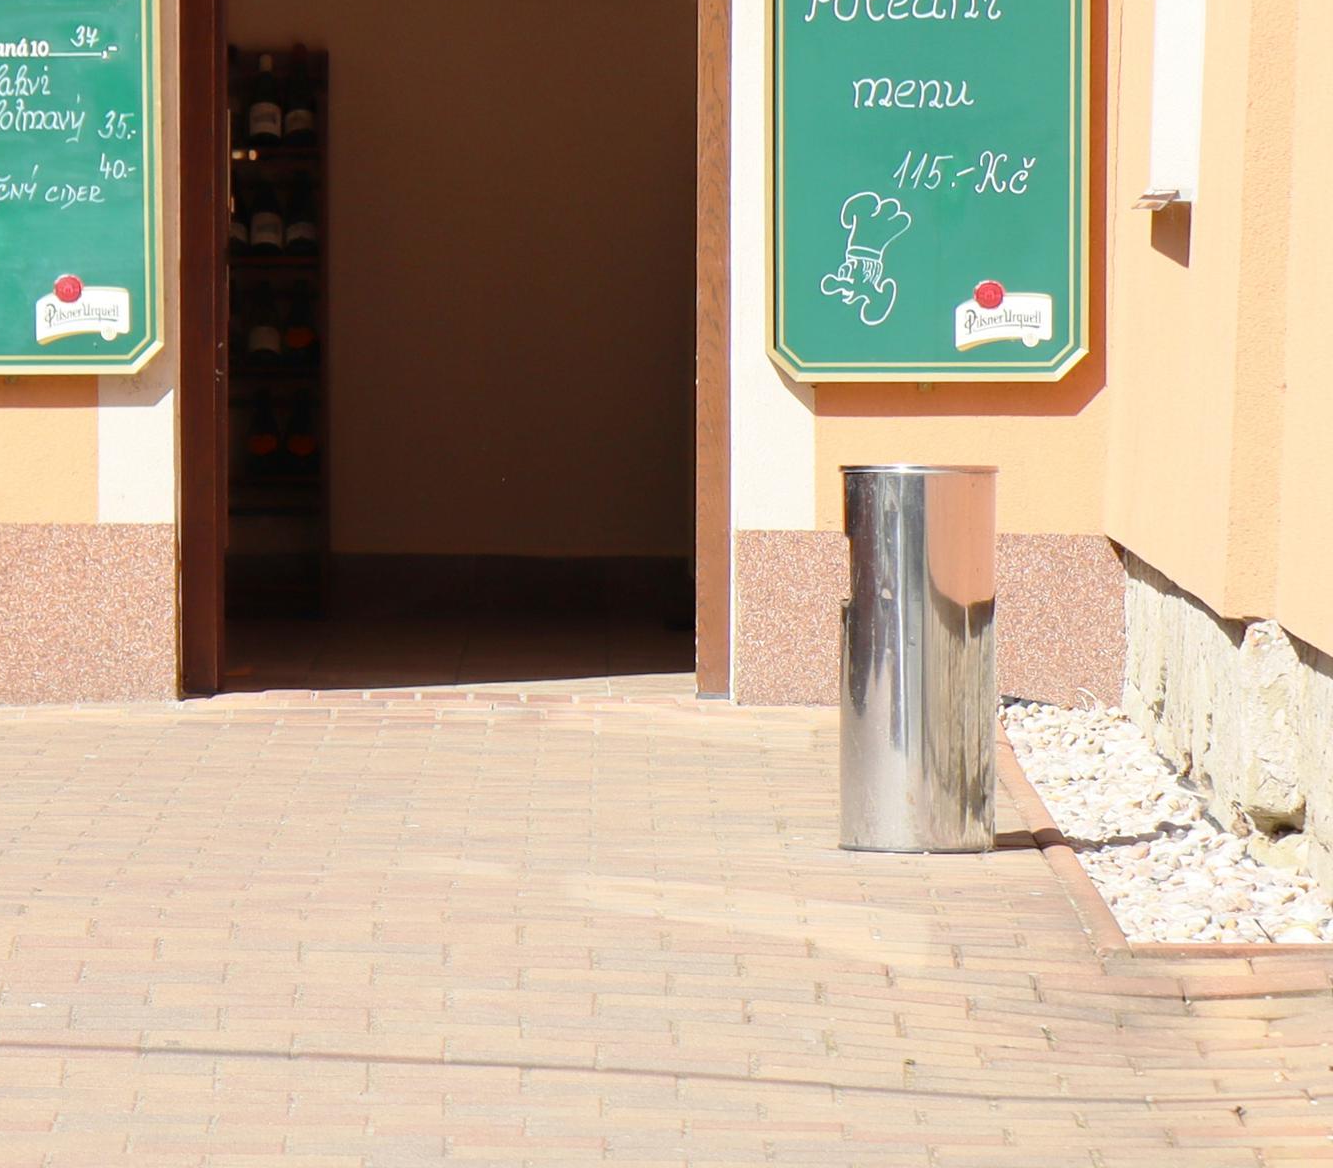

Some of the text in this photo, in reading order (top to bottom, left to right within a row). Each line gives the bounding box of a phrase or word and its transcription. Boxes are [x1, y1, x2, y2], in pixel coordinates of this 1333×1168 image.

[30, 40, 50, 58] 10
[851, 76, 976, 109] menu
[44, 184, 106, 210] CIDER
[44, 302, 119, 328] Pilsner Urquell
[964, 308, 1042, 334] Pilsner Urquell
